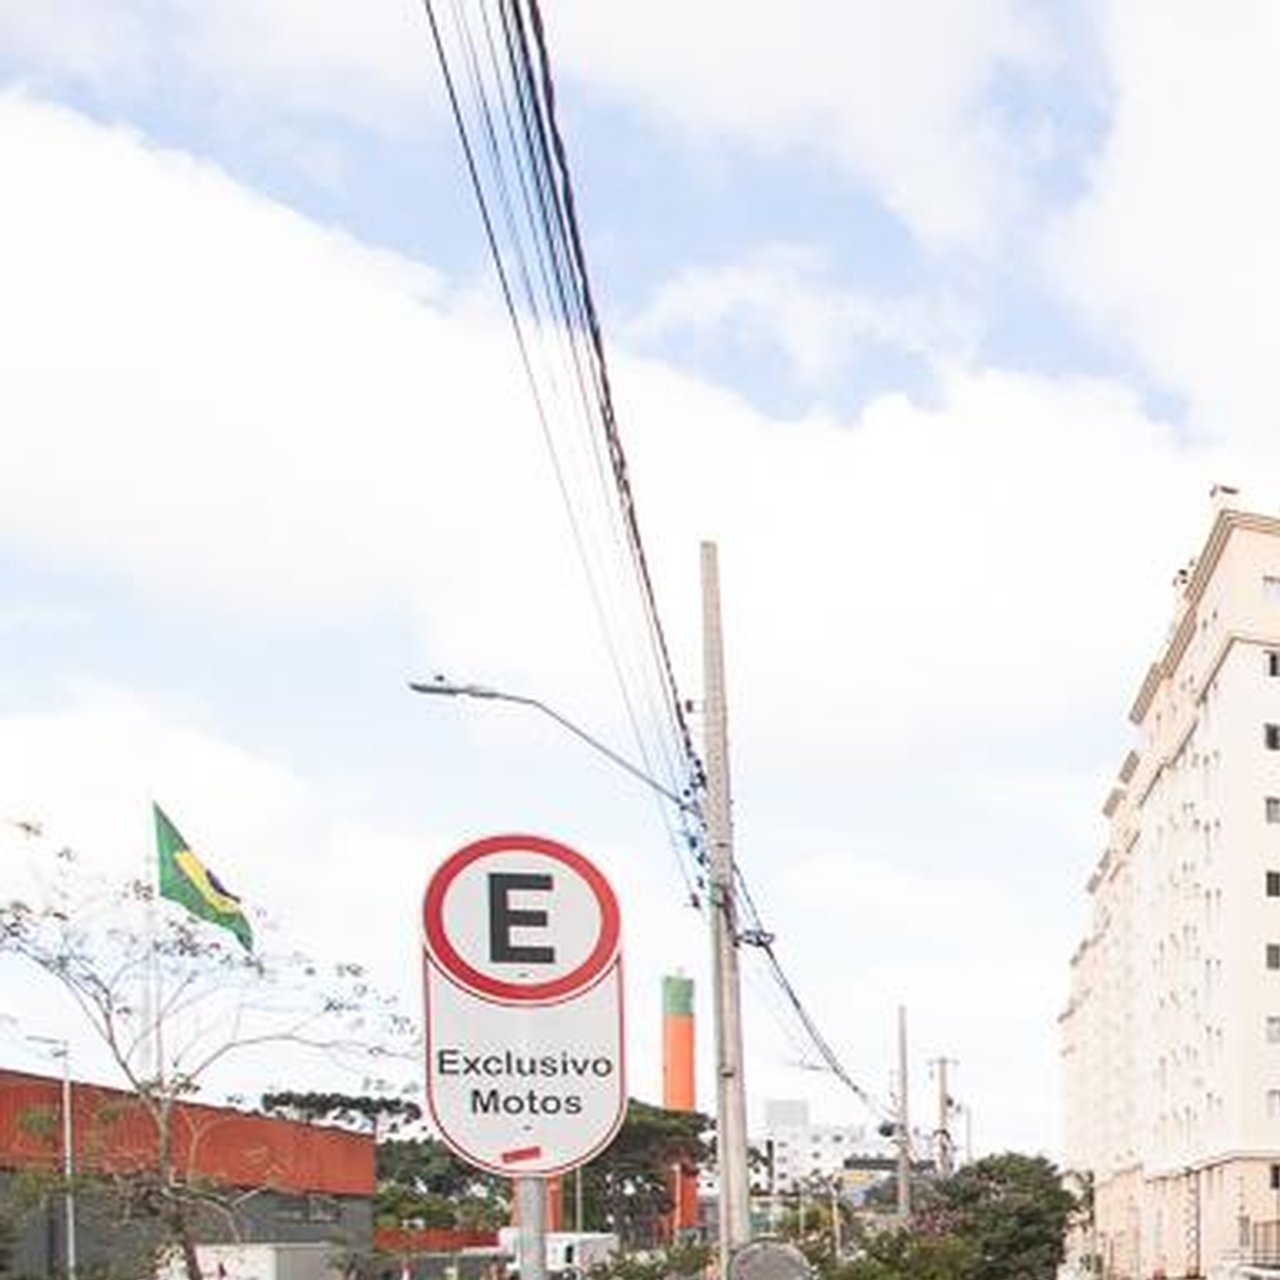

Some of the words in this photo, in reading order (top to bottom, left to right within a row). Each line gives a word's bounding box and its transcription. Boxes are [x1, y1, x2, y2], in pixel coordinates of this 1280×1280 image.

[488, 872, 555, 964] E
[437, 1048, 613, 1078] Exclusivo
[470, 1089, 583, 1115] Motos
